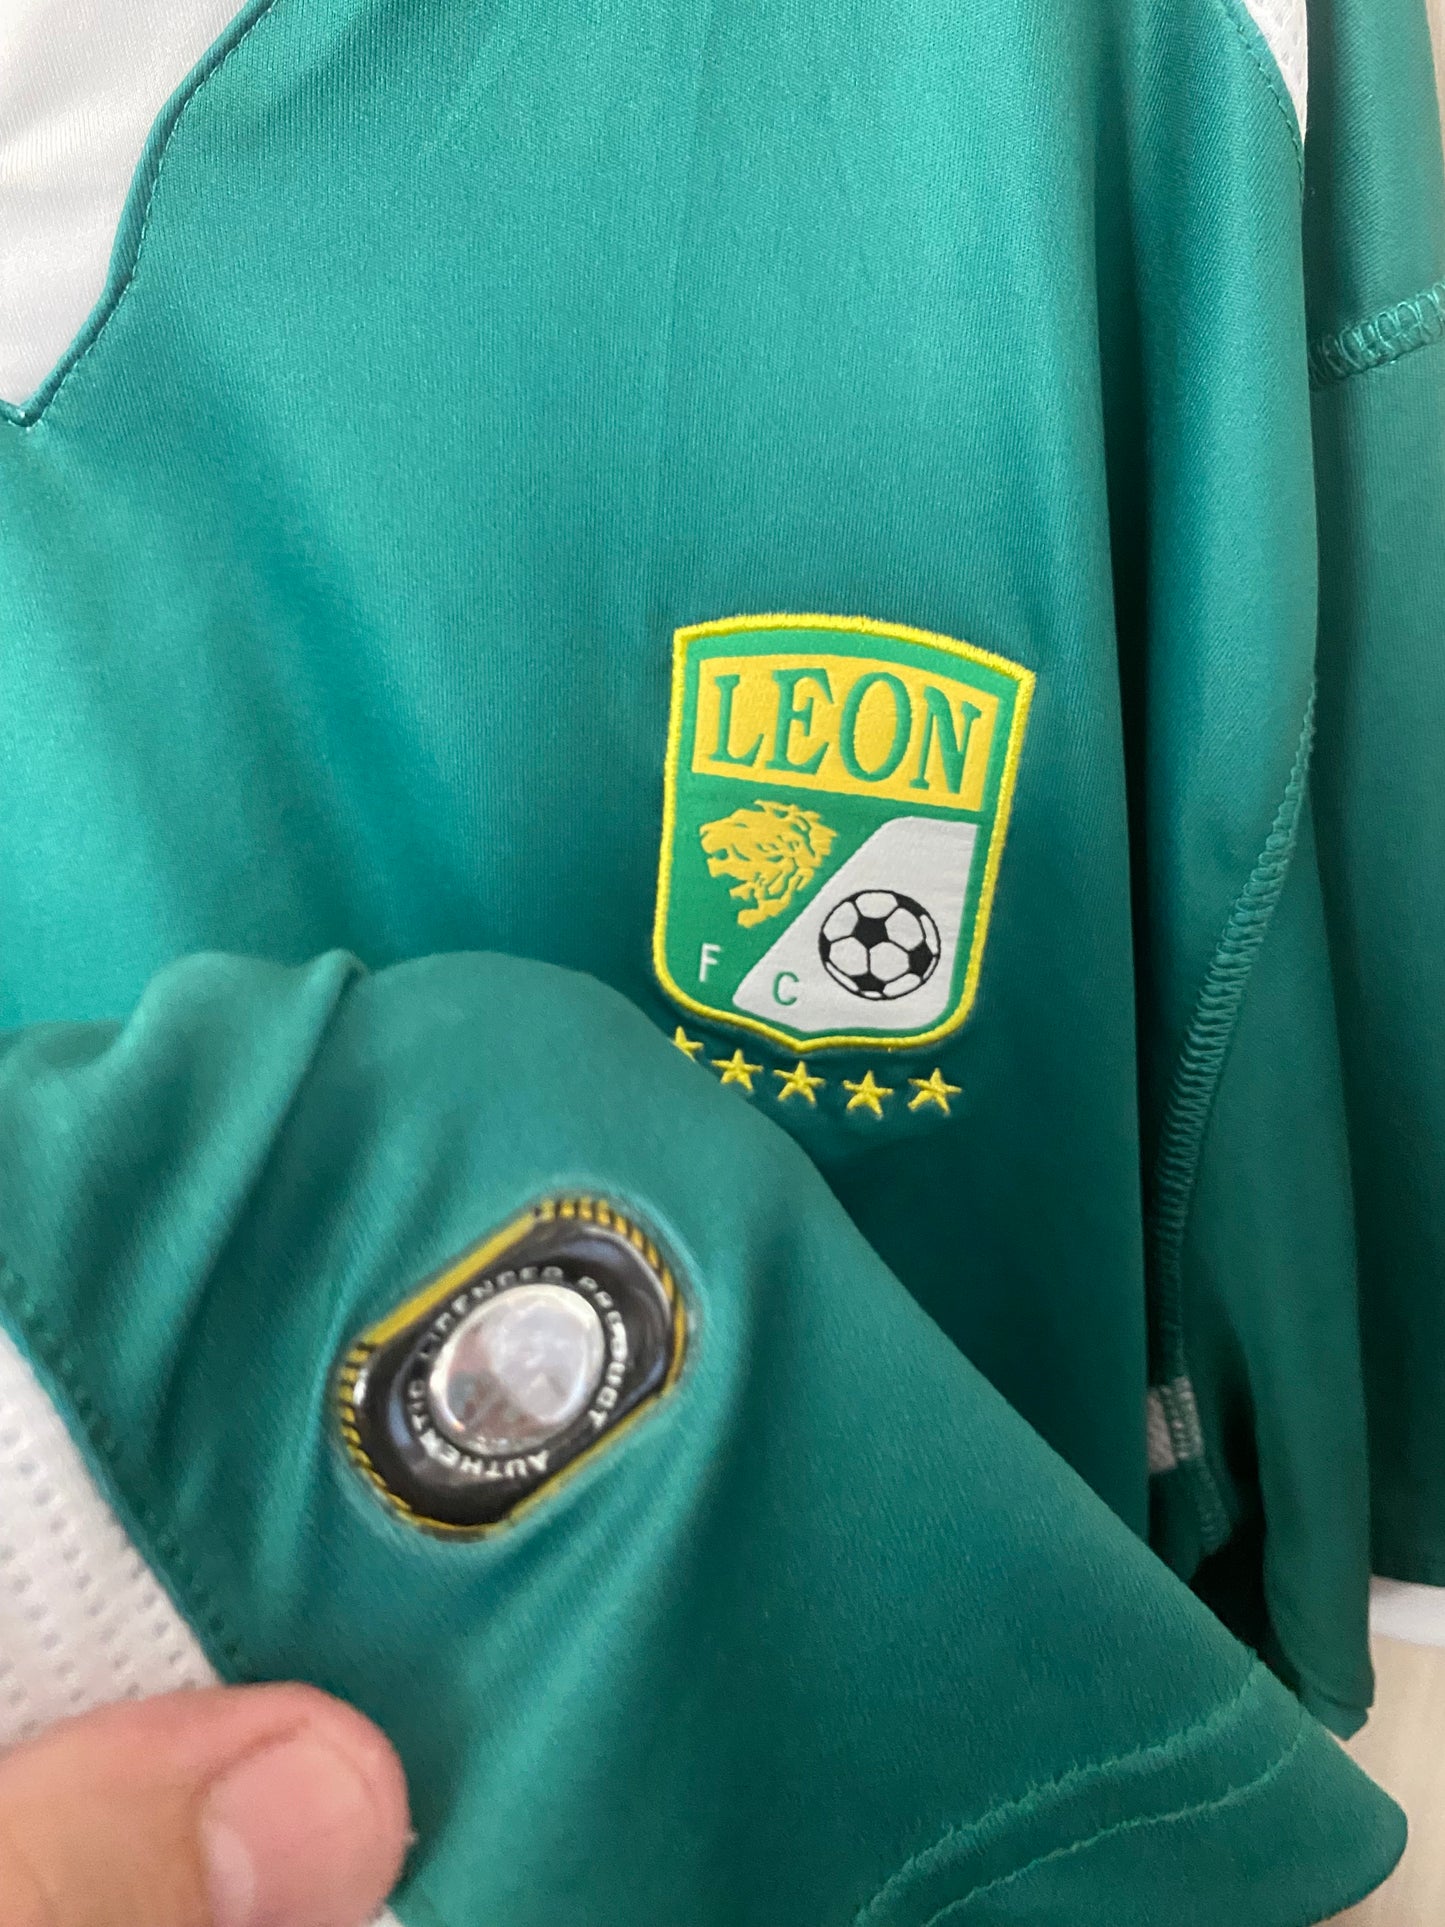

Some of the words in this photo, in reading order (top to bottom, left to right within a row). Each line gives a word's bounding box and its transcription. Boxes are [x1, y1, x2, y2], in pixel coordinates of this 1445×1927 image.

[708, 667, 982, 794] LEON
[698, 943, 721, 983] F
[771, 971, 801, 1007] C
[408, 1380, 552, 1480] AUTHENTIC
